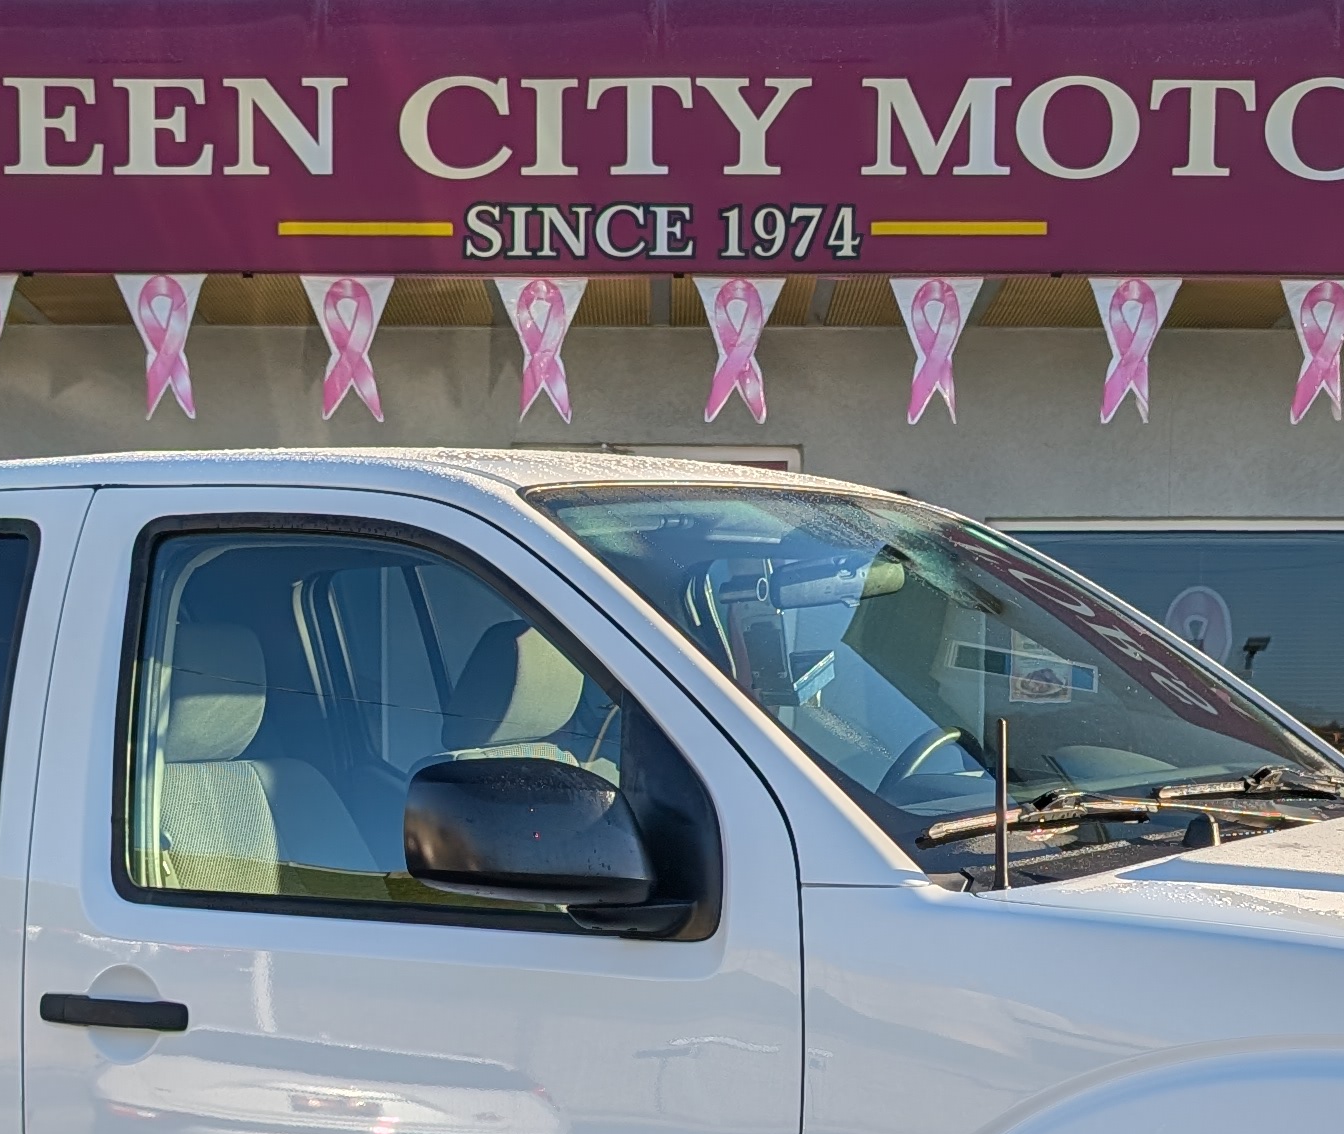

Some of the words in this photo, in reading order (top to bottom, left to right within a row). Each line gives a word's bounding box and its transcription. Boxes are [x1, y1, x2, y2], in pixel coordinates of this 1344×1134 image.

[399, 75, 813, 180] CITY
[466, 204, 693, 258] SINCE
[719, 206, 860, 258] 1974
